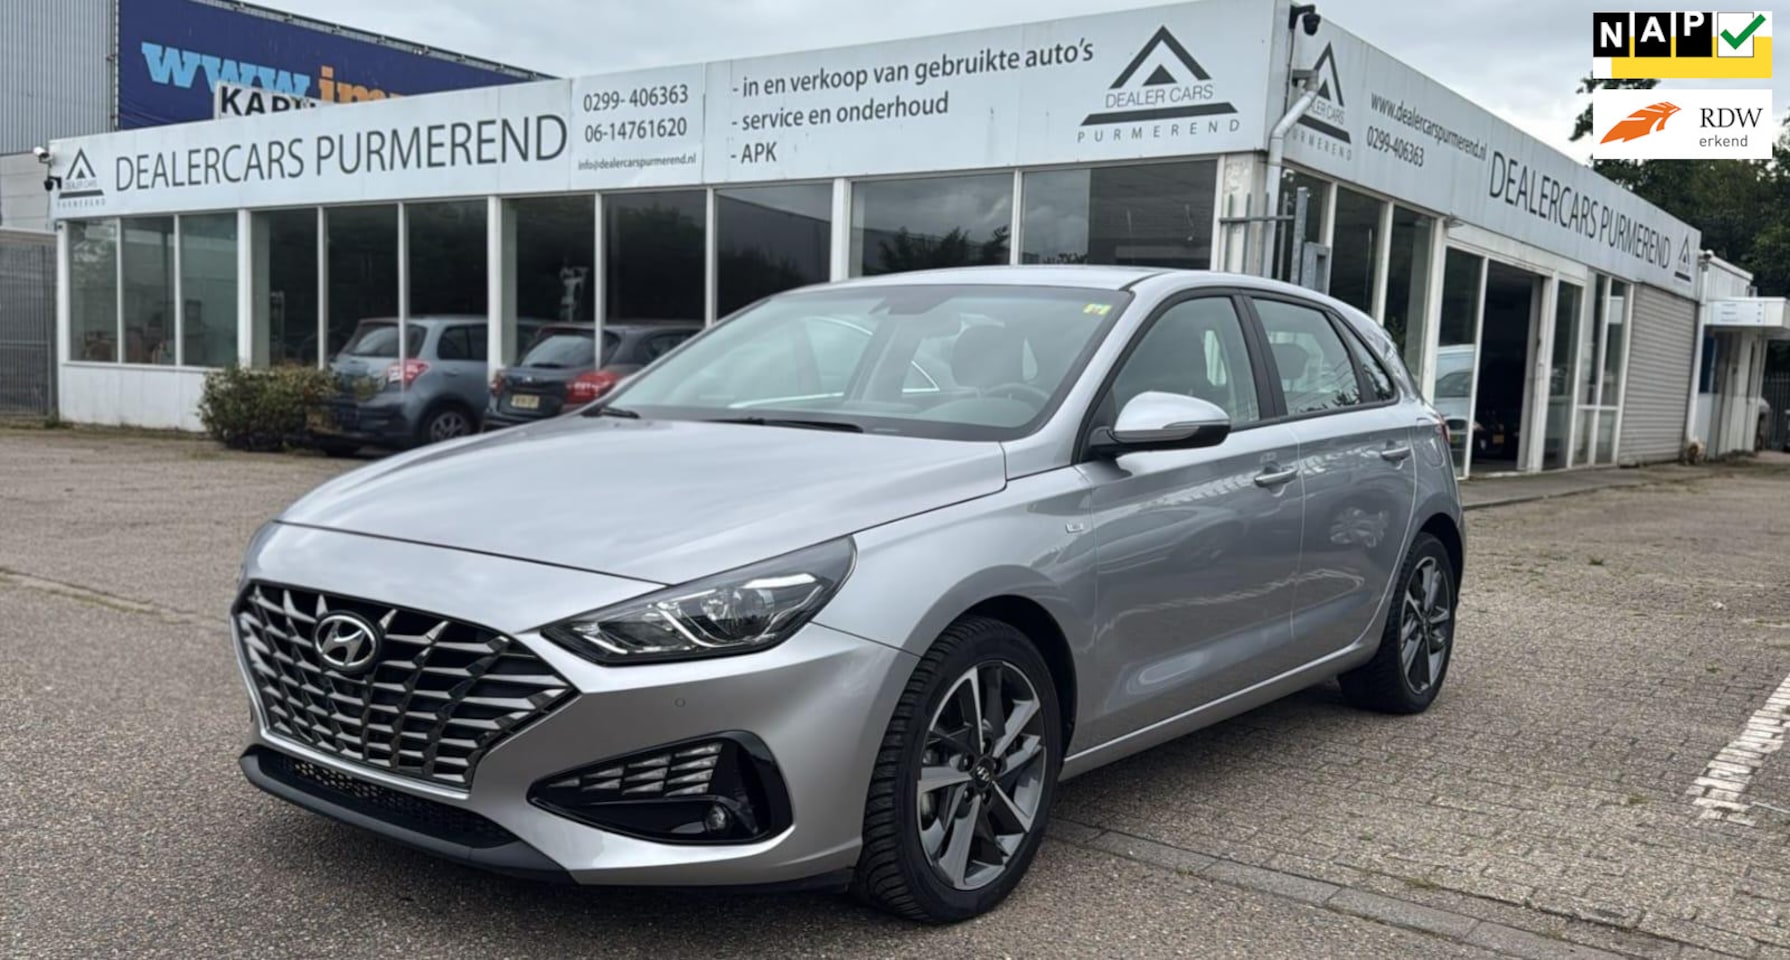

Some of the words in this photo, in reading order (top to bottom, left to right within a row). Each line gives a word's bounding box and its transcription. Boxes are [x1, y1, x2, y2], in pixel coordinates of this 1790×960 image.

[742, 76, 759, 97] in
[764, 76, 786, 95] en
[790, 67, 868, 92] verkoop
[873, 63, 909, 84] van
[914, 48, 1020, 86] gebruikte
[629, 84, 689, 107] 406363
[741, 107, 804, 131] service
[808, 108, 831, 125] en
[836, 90, 949, 123] onderhoud
[1105, 88, 1166, 109] DEALER
[1169, 84, 1214, 102] CARS
[584, 117, 688, 143] 06-14761620
[1077, 118, 1240, 144] PURMEREND
[1292, 127, 1352, 162] URMEREND
[1370, 92, 1488, 161] www.dealercarspurmerend.nl
[116, 138, 305, 192] DEALERCARS
[316, 113, 568, 177] PURMEREND
[740, 141, 777, 164] APK
[1366, 125, 1424, 167] 0299-406363
[1489, 151, 1599, 239] DEALERCARS
[1599, 206, 1671, 269] PURMEREND
